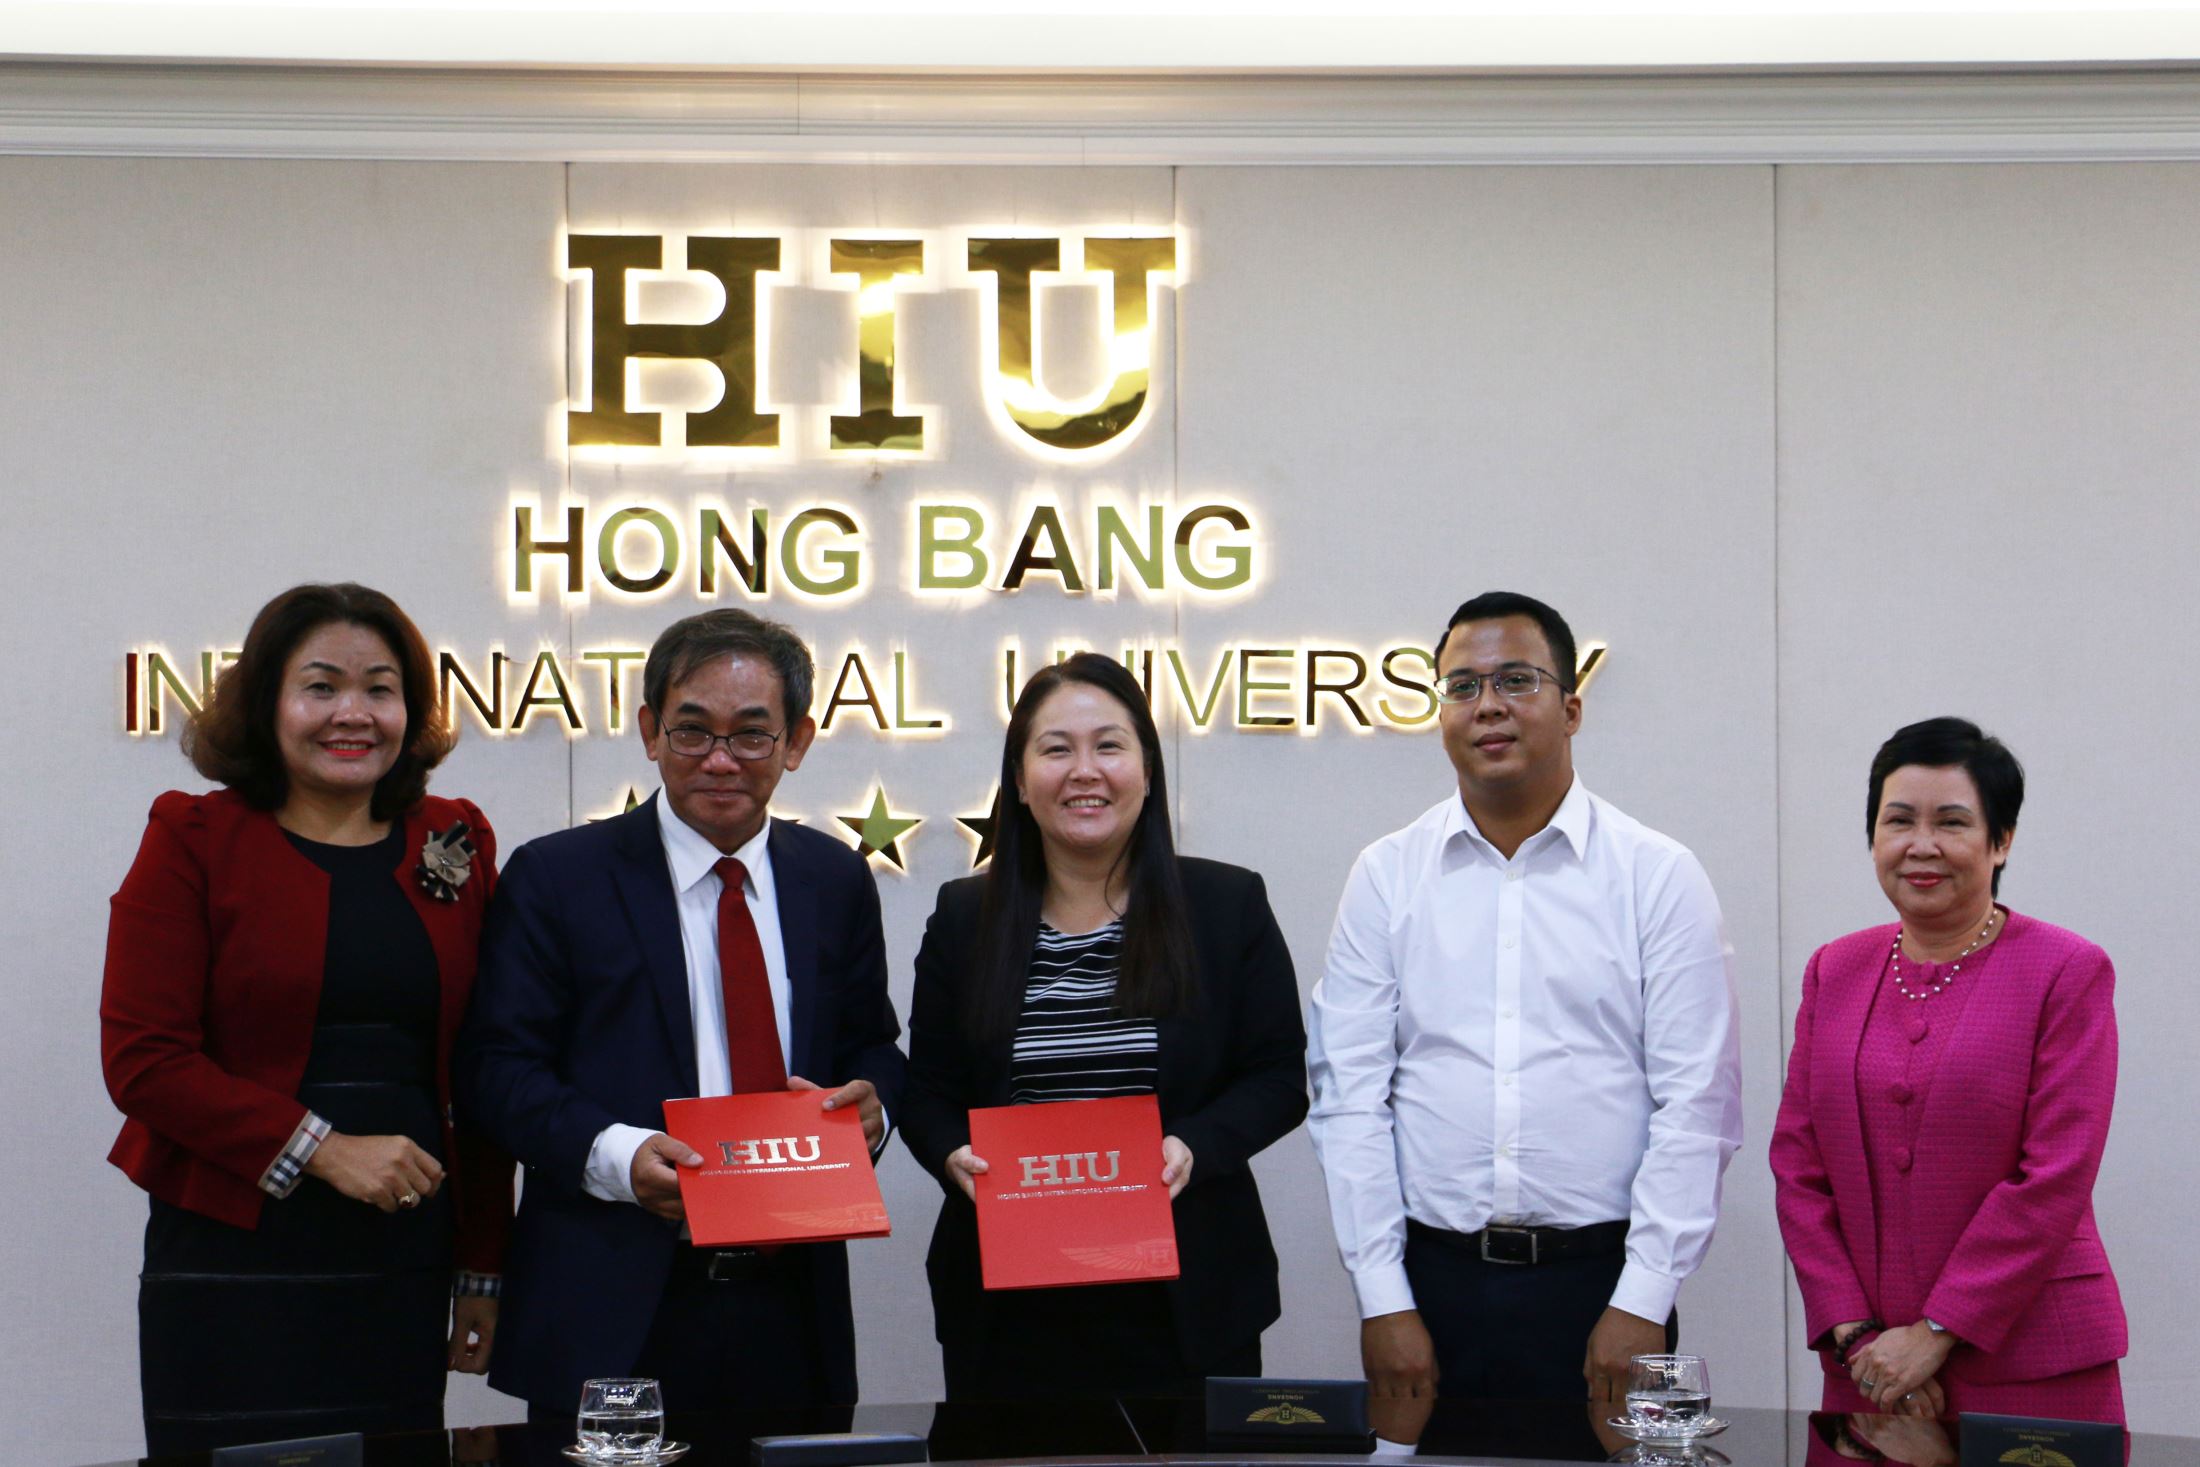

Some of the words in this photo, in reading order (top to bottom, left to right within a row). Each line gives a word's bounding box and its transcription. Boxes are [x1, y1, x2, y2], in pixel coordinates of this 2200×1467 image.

[567, 234, 1177, 451] HIU
[514, 506, 861, 594] HONG
[918, 504, 1253, 592] BANG
[126, 651, 943, 730] INNATAL
[1006, 648, 1606, 727] IVERS
[717, 1135, 820, 1165] HIU
[1018, 1150, 1121, 1188] HIU
